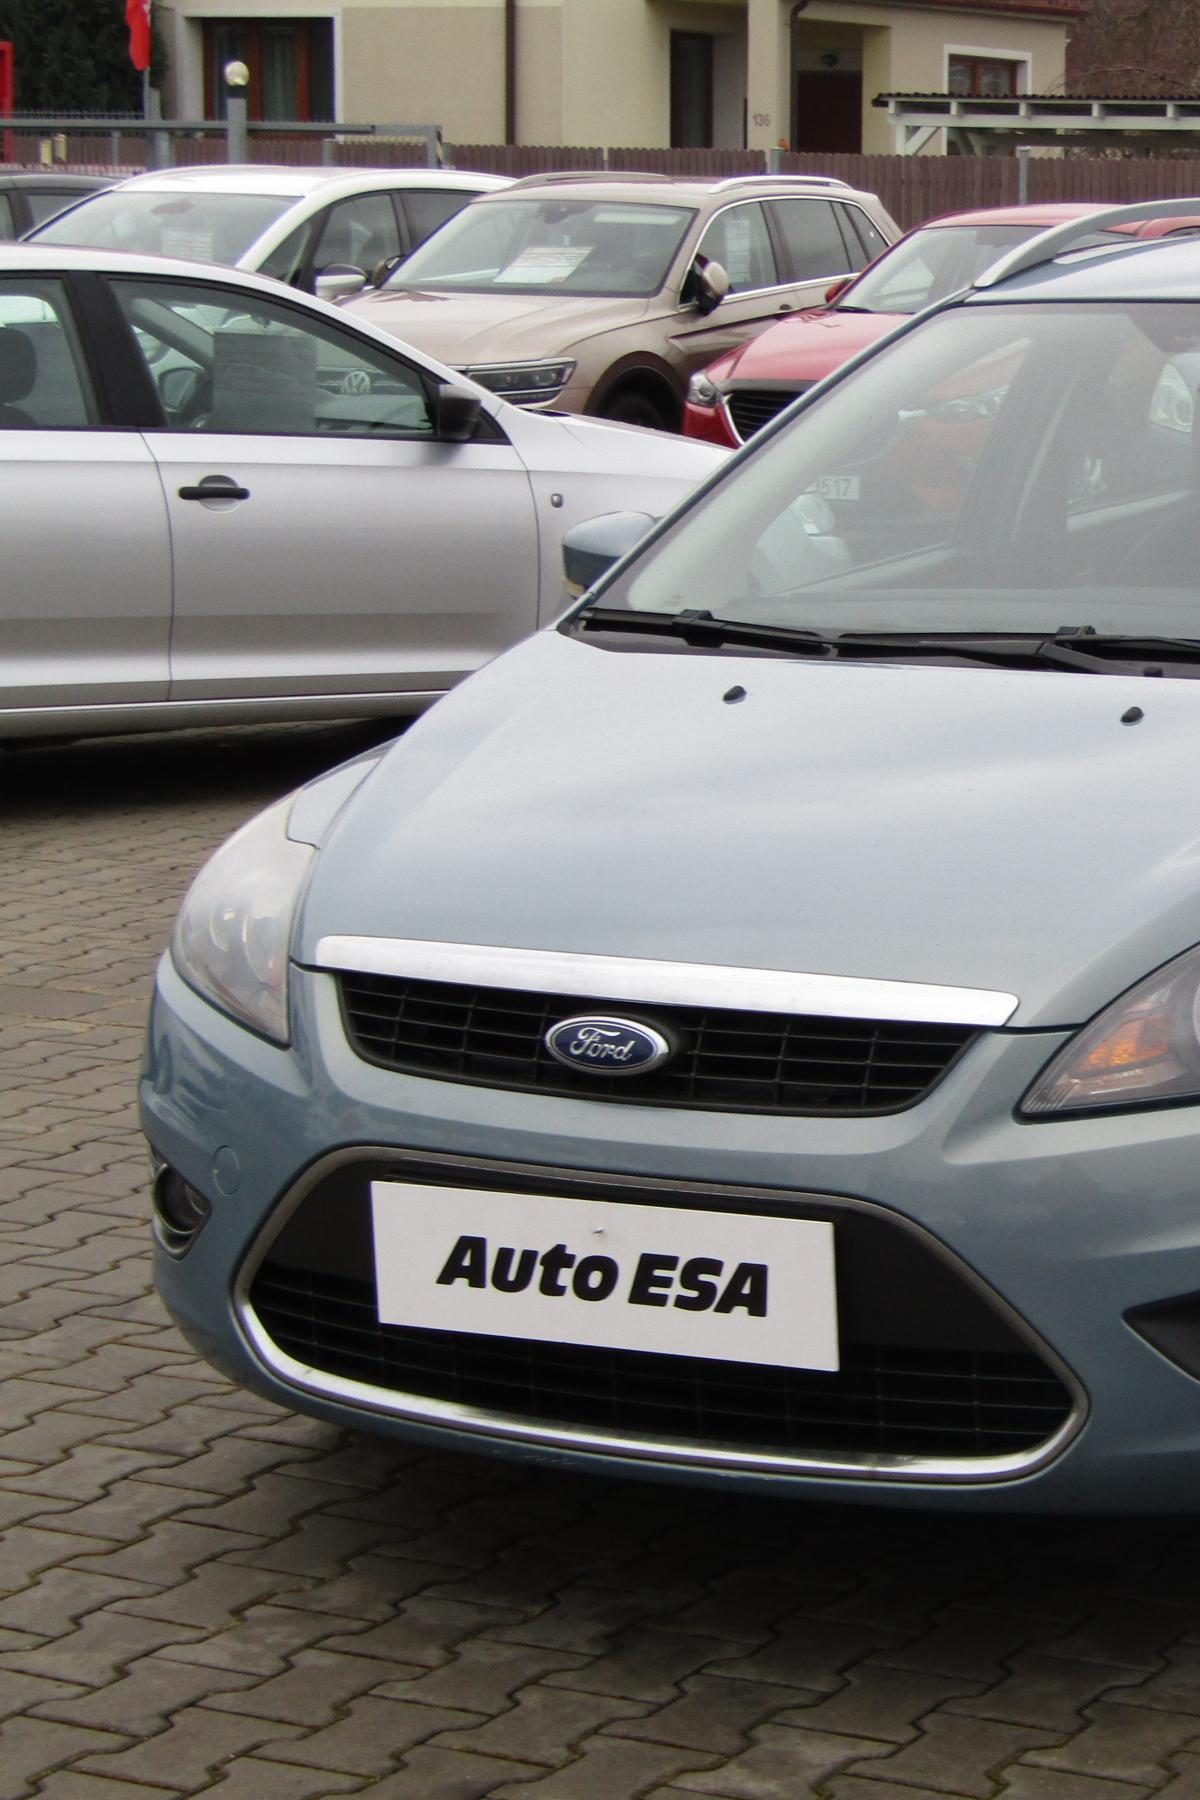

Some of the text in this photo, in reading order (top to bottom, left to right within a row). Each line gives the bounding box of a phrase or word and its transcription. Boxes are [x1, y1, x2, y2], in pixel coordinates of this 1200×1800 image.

[569, 1027, 636, 1061] Ford
[436, 1235, 769, 1318] Auto ESA
